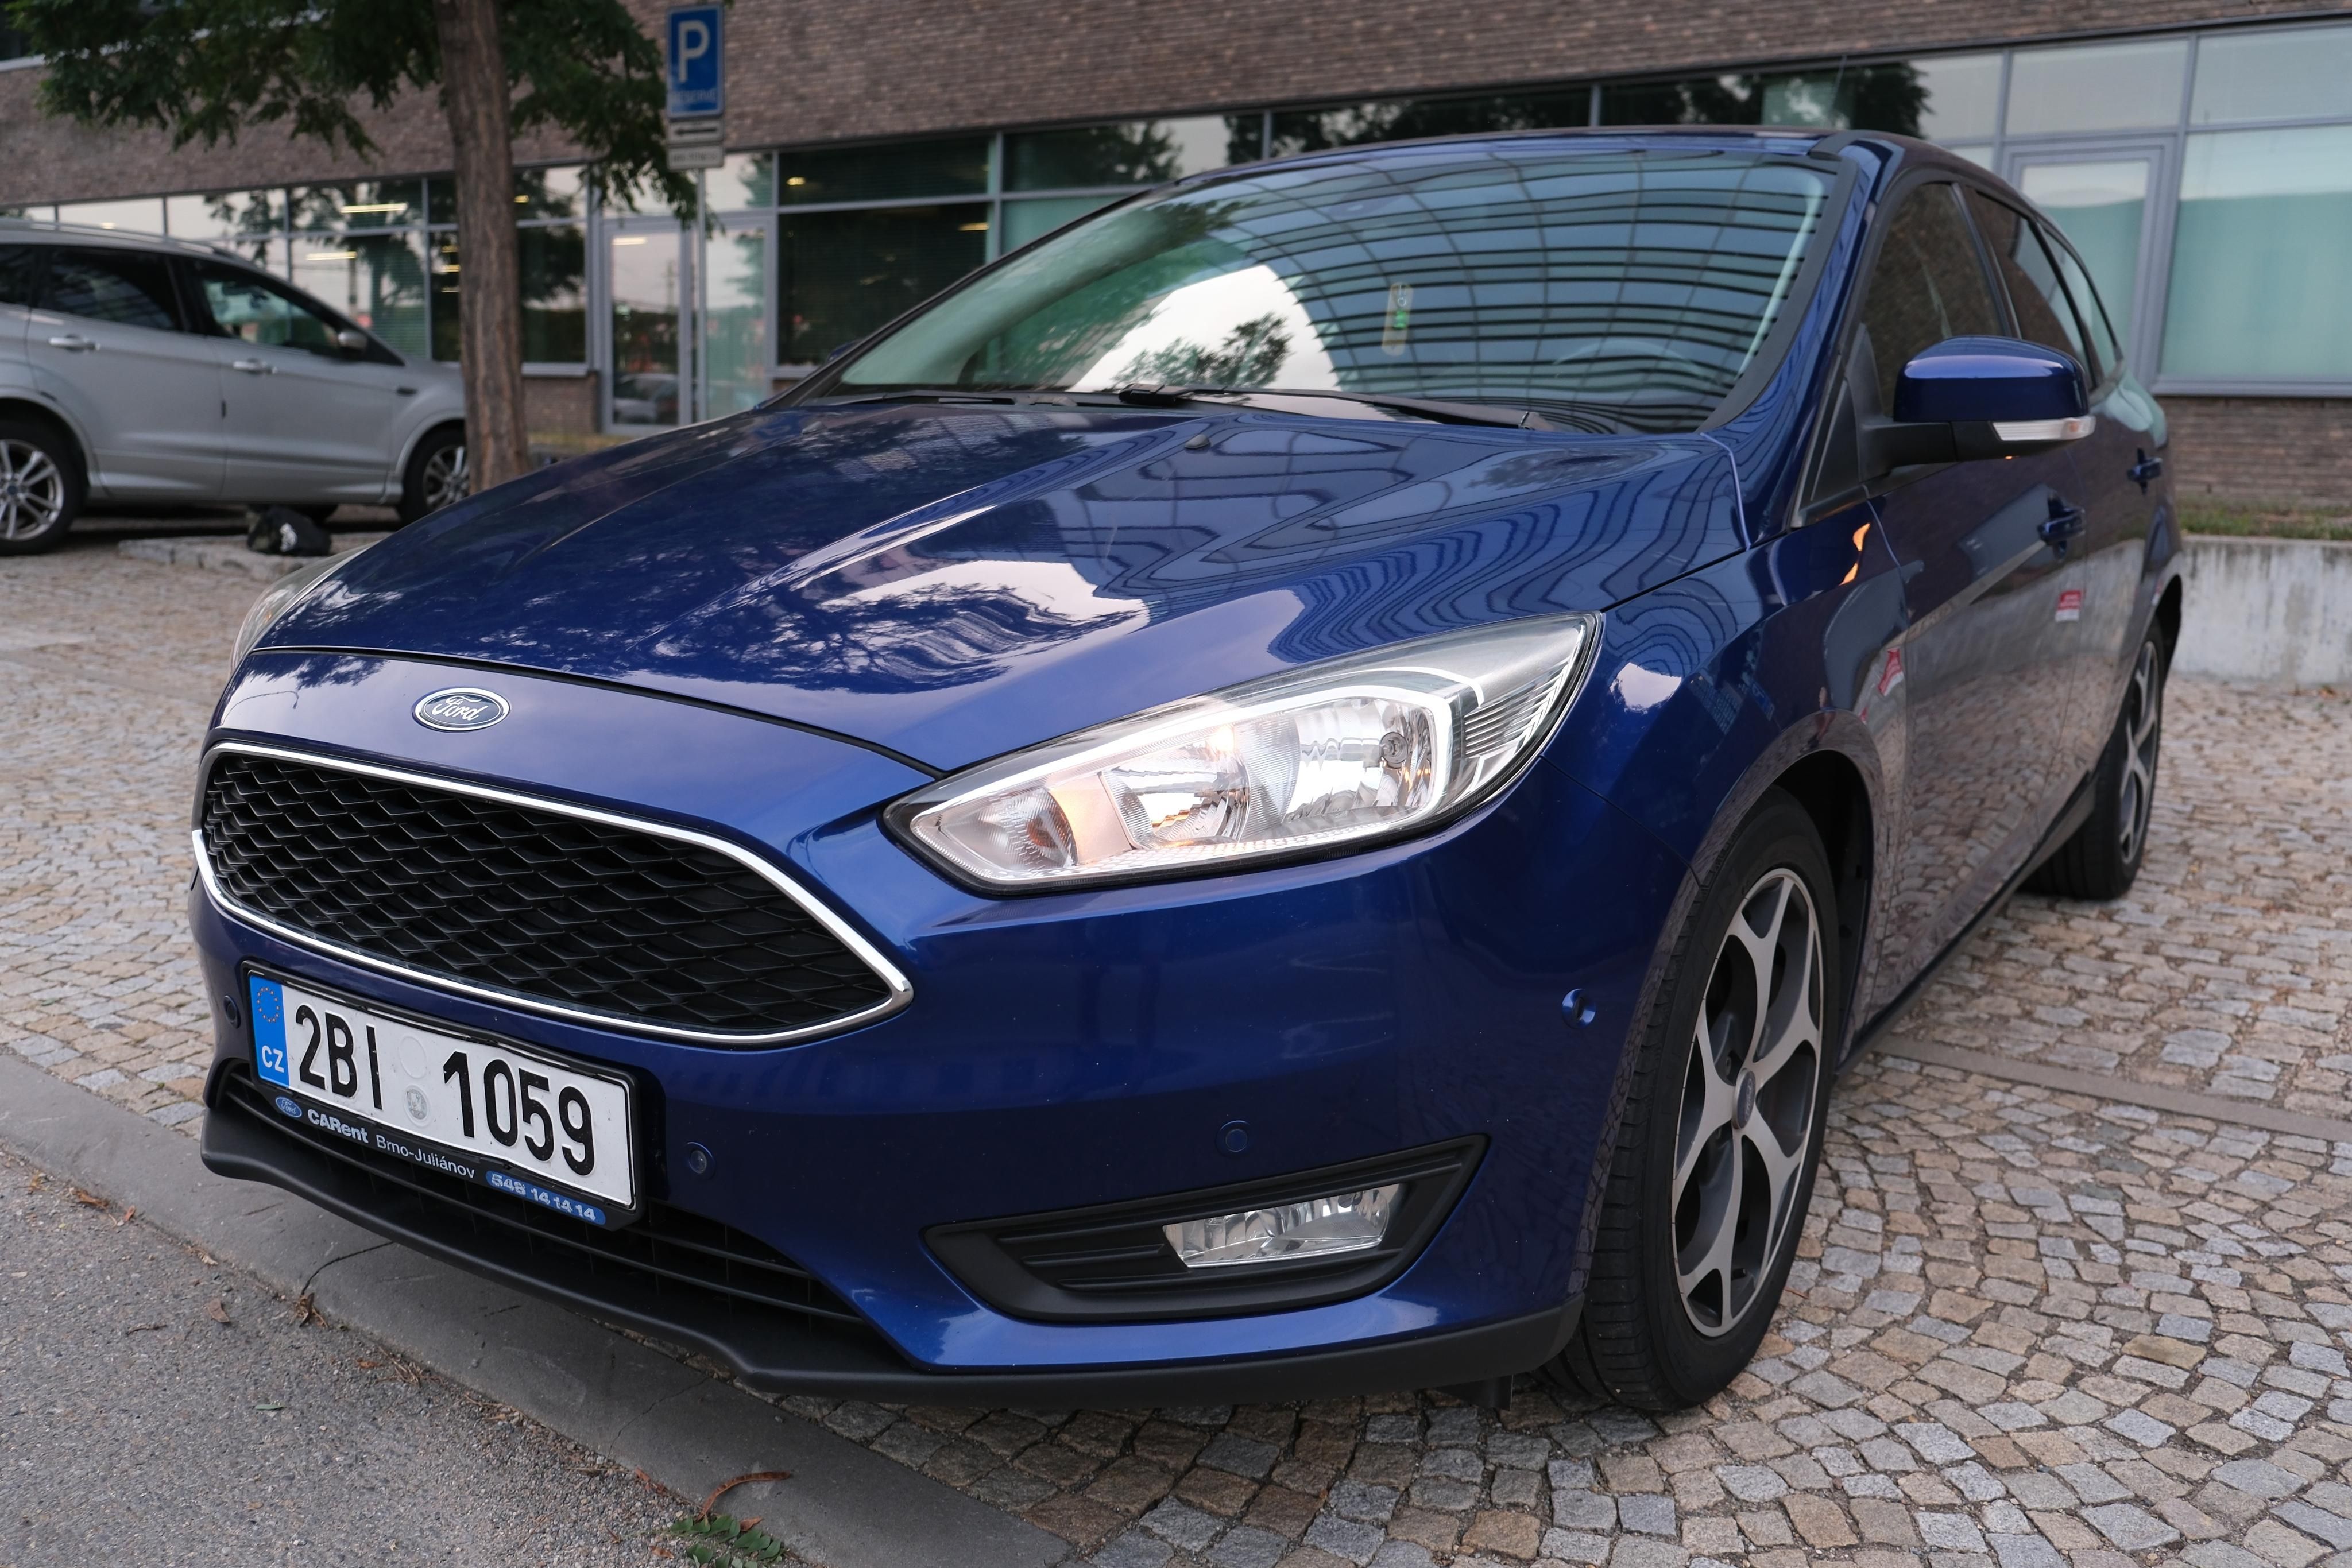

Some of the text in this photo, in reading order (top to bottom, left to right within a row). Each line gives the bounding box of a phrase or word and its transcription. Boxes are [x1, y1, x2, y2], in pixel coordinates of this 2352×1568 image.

[678, 20, 710, 83] P
[432, 695, 488, 721] Ford
[262, 1045, 285, 1073] CZ
[295, 1004, 595, 1176] 2BI 1059
[280, 1099, 297, 1115] Ford
[307, 1109, 475, 1179] CARent Brno-Juliánov
[531, 1188, 551, 1205] 14
[553, 1196, 573, 1213] 14
[575, 1204, 596, 1221] 14
